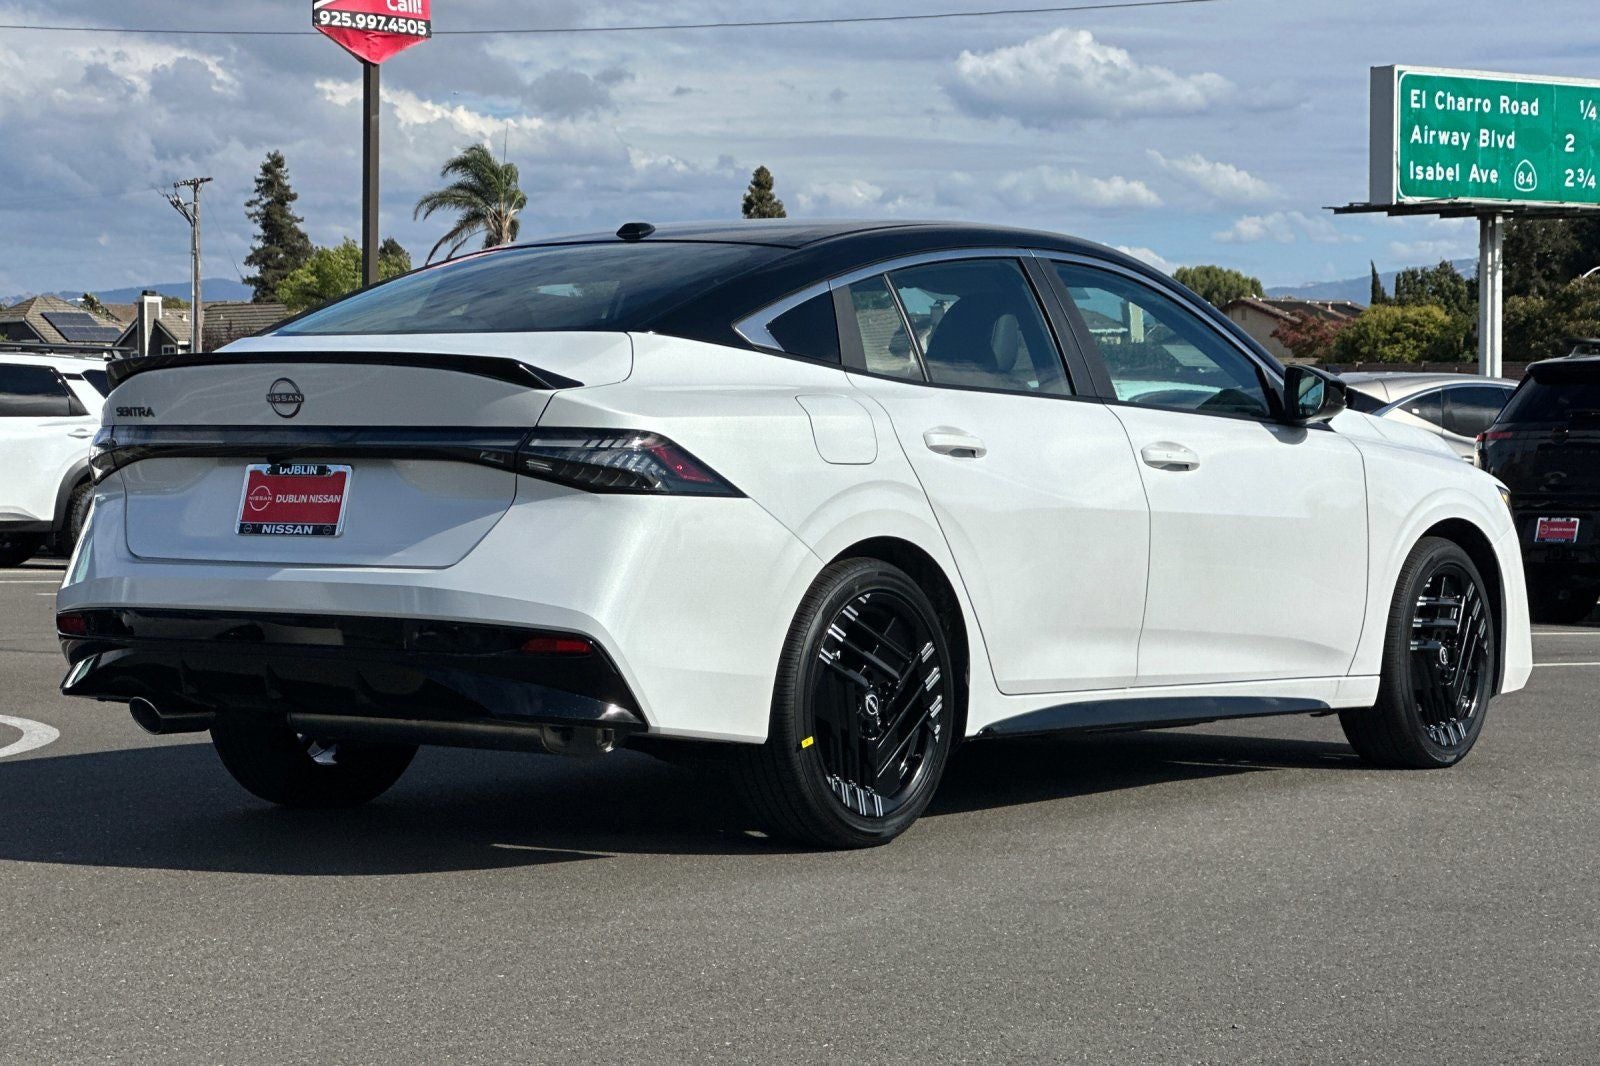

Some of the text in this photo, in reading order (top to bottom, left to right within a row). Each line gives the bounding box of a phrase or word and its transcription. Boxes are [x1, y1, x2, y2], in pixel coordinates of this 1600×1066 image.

[386, 0, 423, 14] Call!
[319, 10, 427, 35] 925.997.4505
[1410, 89, 1426, 109] El
[1434, 90, 1492, 113] Charro
[1499, 95, 1539, 116] Road
[1410, 125, 1575, 152] Airway Blvd 2
[1409, 160, 1460, 182] Isabel
[1469, 163, 1499, 184] Ave
[1517, 171, 1533, 186] 84
[266, 393, 303, 403] NISSAN
[115, 406, 156, 418] SENTRA
[279, 465, 318, 475] DUBLIN
[275, 494, 342, 504] DUBLIN NISSAN
[261, 524, 314, 535] NISSAN
